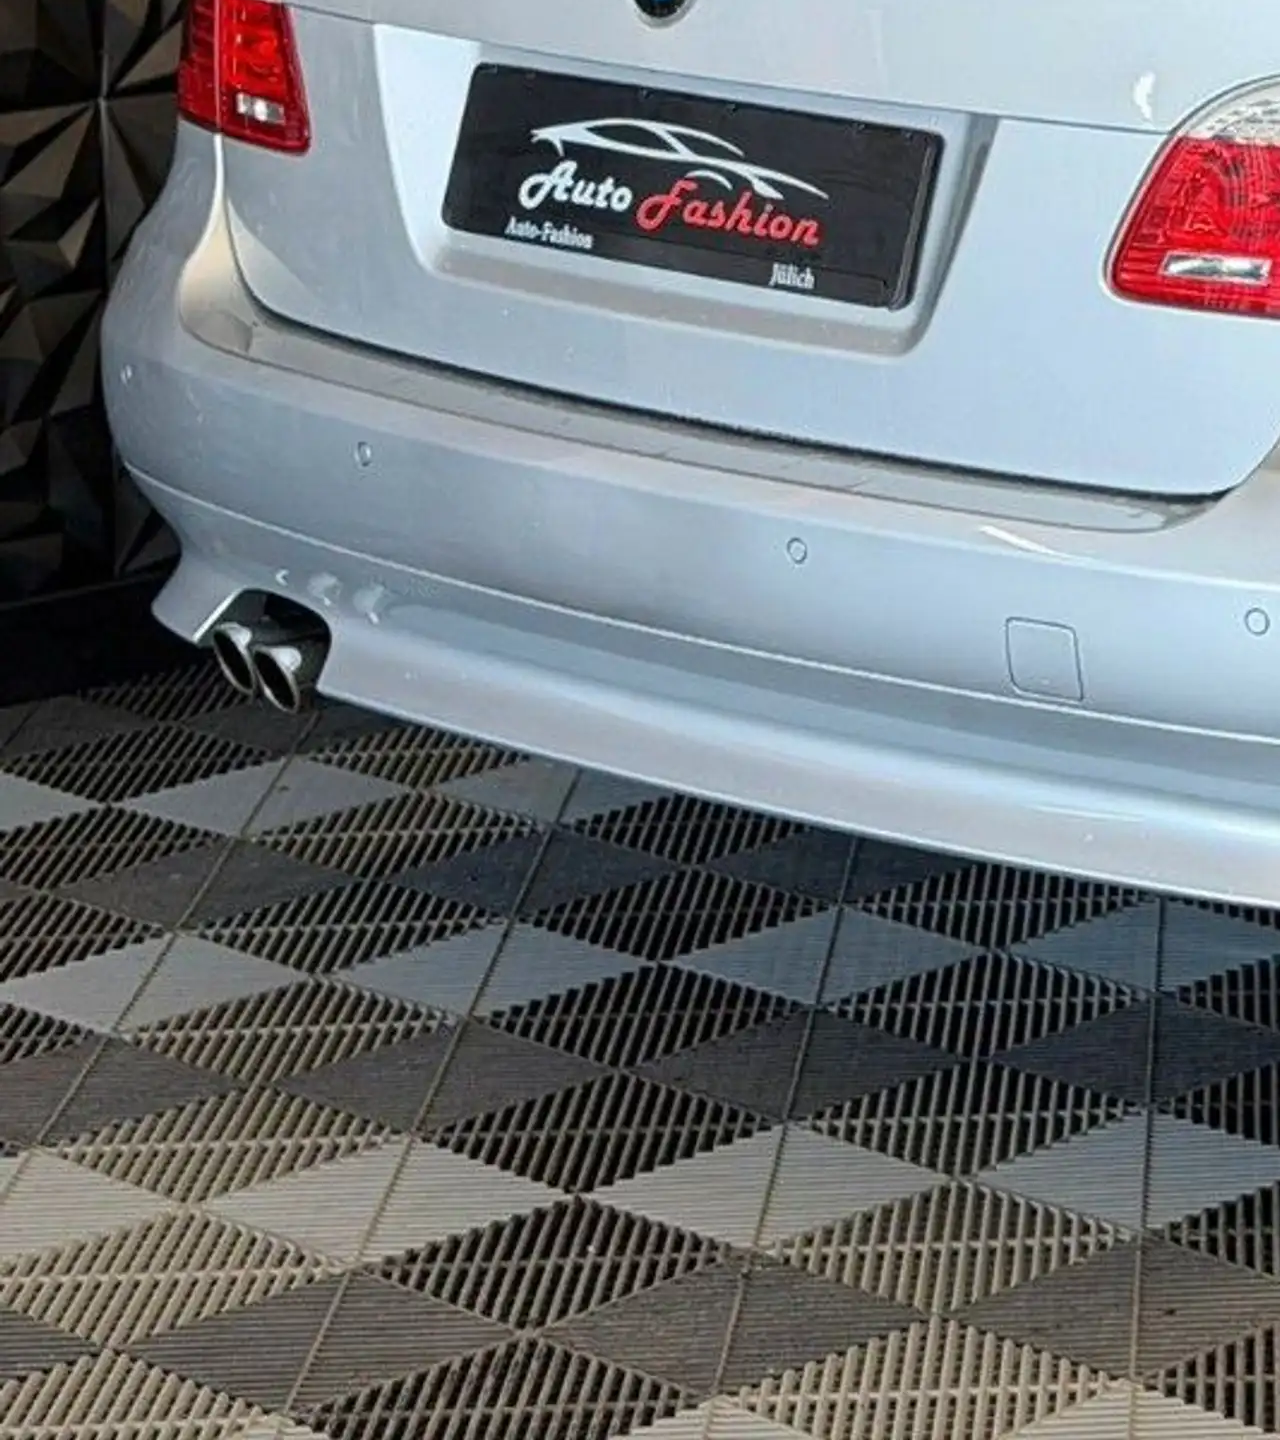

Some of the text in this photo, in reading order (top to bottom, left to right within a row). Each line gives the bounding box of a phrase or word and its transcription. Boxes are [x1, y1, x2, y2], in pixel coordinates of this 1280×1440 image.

[518, 160, 820, 247] Auto Fashion
[504, 216, 593, 250] Auto-Fashion
[768, 262, 816, 290] Jülich
